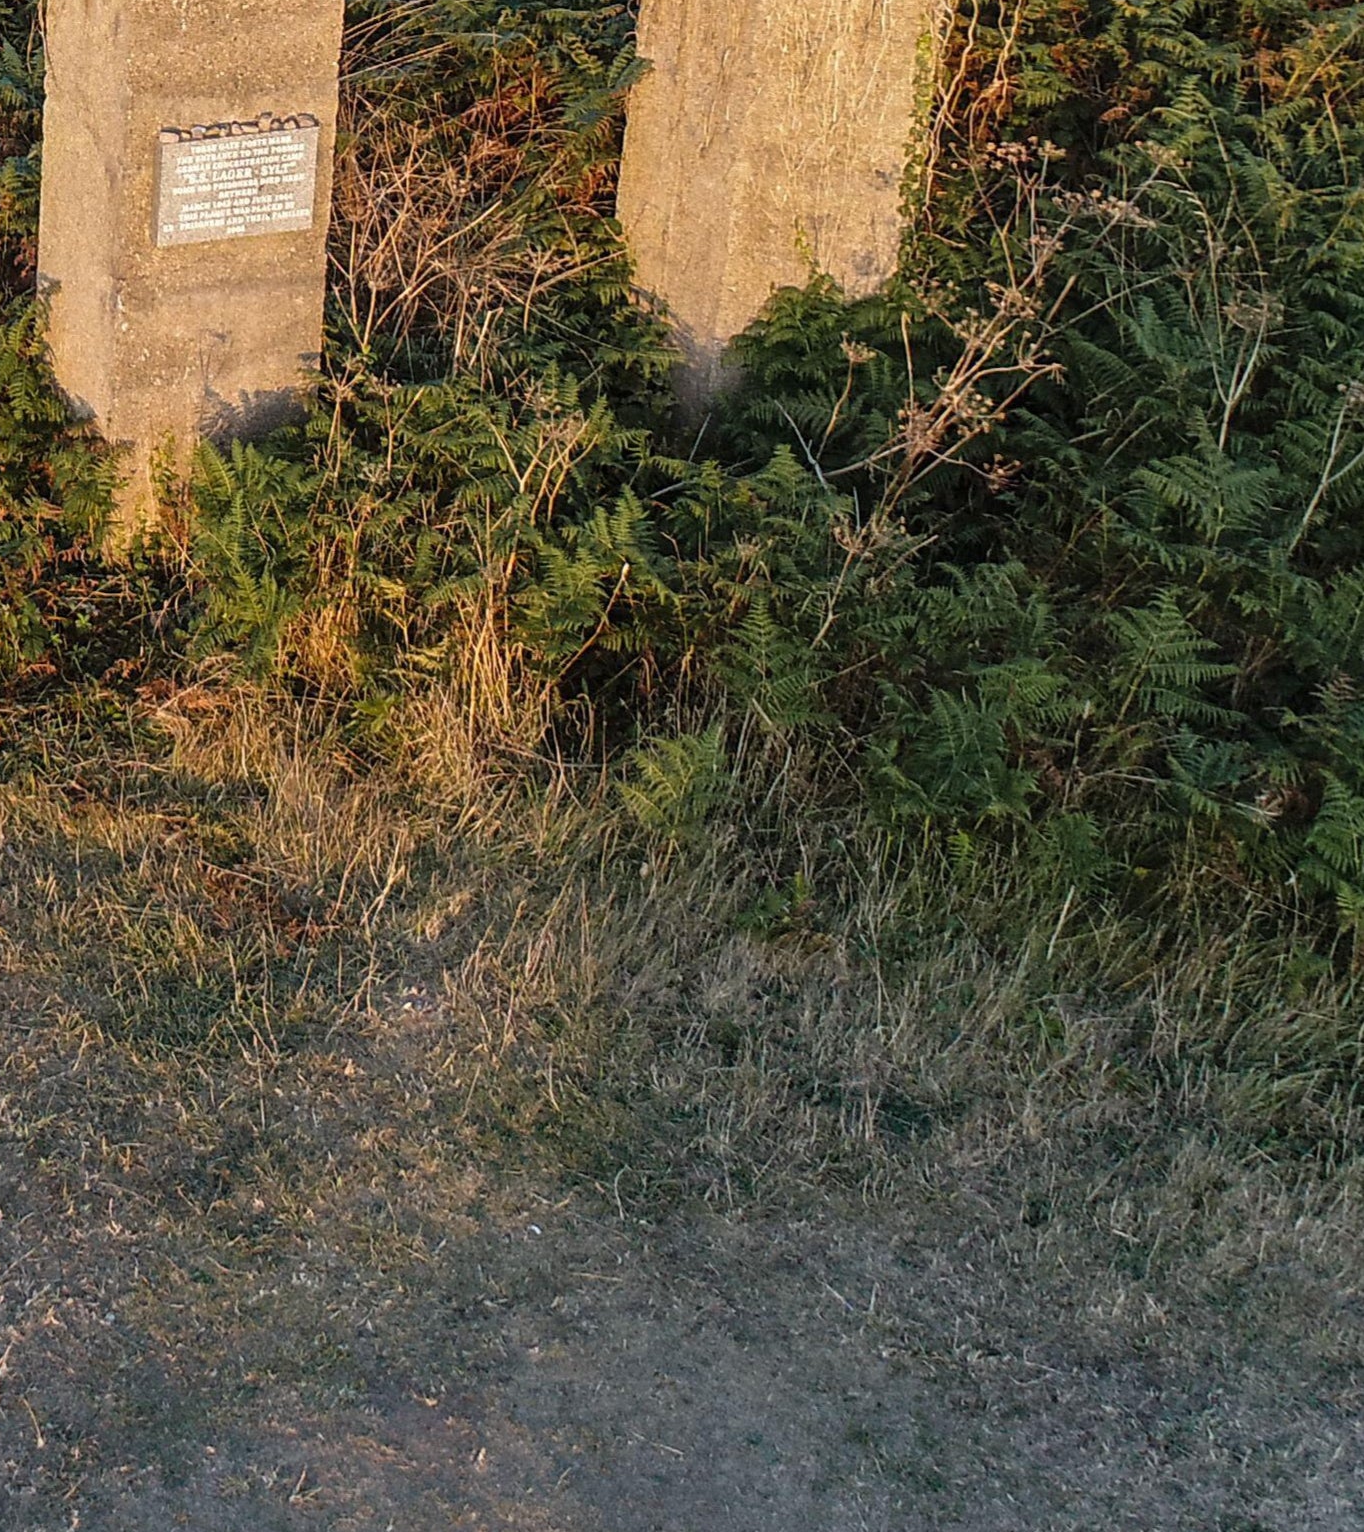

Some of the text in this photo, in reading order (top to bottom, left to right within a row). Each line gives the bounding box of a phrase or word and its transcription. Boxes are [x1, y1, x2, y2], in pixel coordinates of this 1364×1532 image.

[191, 135, 292, 154] THESE GATE POSTS MARK
[177, 143, 305, 166] THE ENTRANCE TO THE FORMER
[176, 153, 304, 174] GERMAN CONCENTRATION CAMP
[213, 168, 253, 182] LAGER
[172, 185, 196, 196] SOME
[260, 176, 281, 185] DIED
[282, 173, 307, 183] HERE
[219, 188, 258, 199] BETWEEN
[233, 197, 251, 206] AND
[252, 195, 273, 204] JUNE
[234, 207, 250, 216] WAS
[252, 203, 283, 214] PLACED
[285, 201, 295, 210] BY
[226, 217, 245, 225] AND
[246, 213, 270, 223] THEIR
